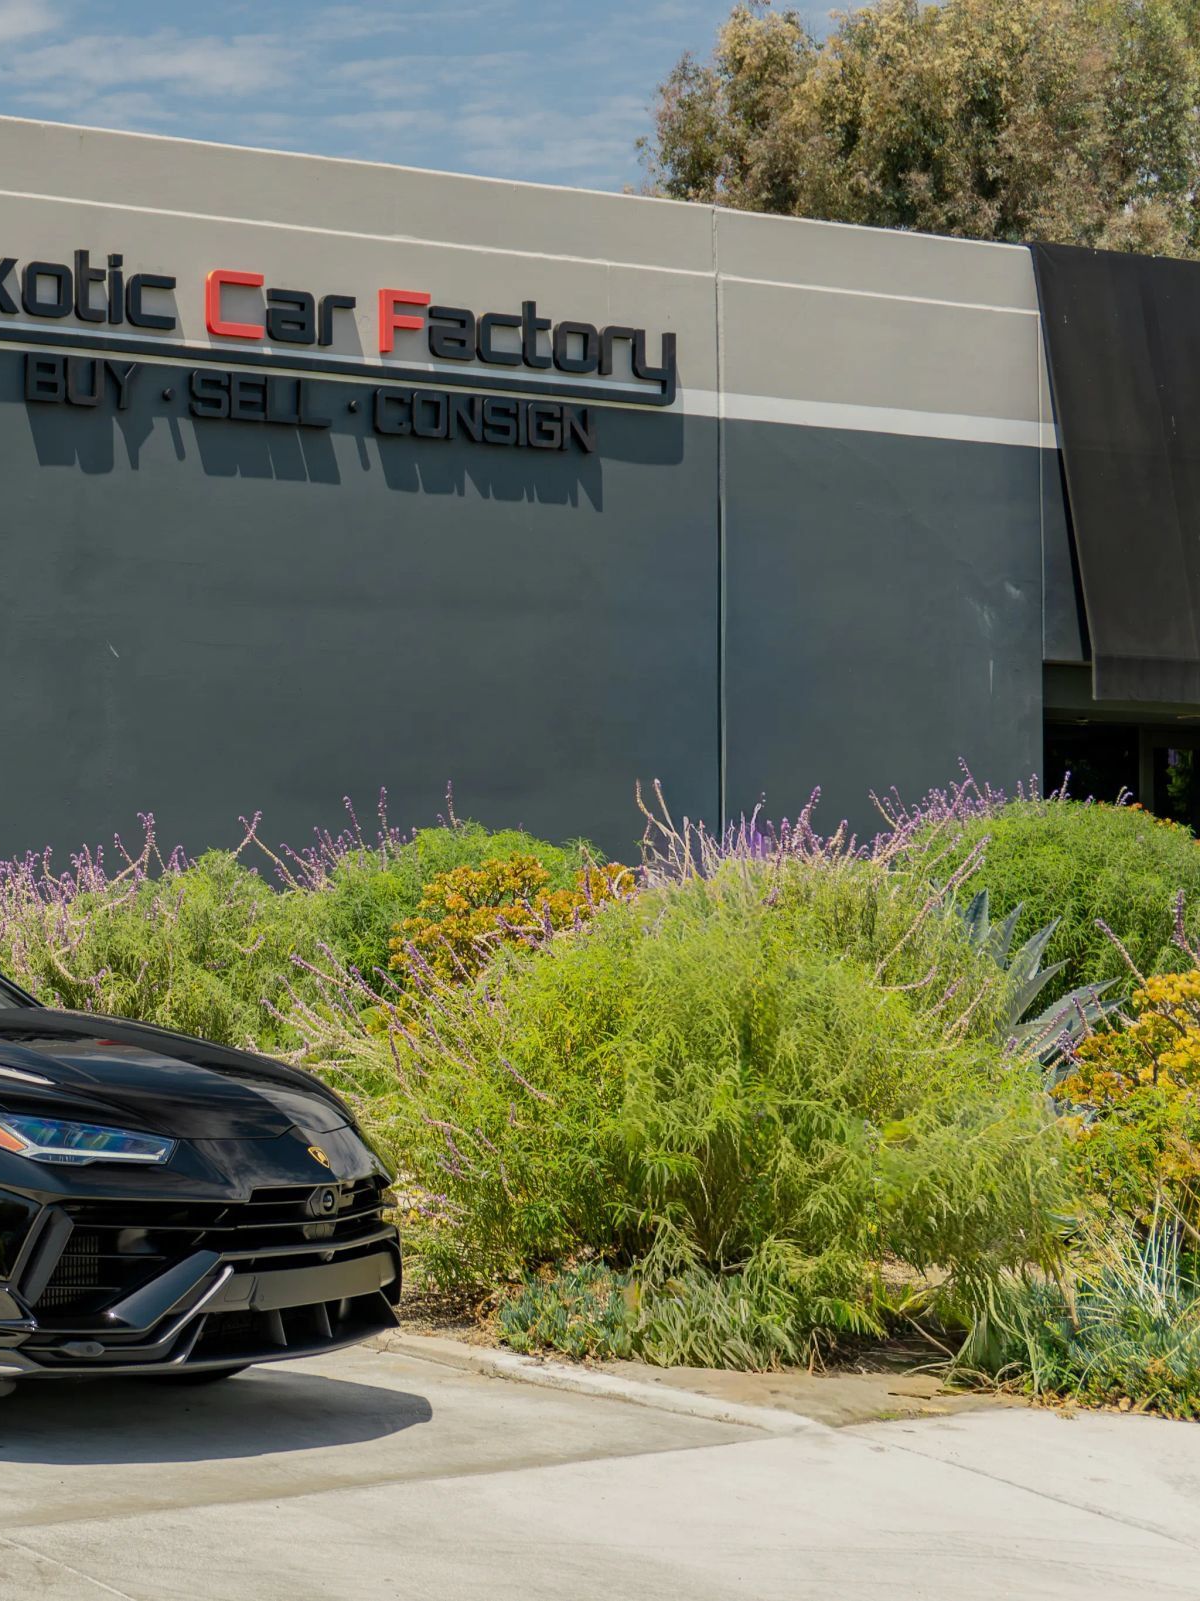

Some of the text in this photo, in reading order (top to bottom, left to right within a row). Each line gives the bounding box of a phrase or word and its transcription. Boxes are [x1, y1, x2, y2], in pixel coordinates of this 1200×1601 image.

[205, 269, 356, 346] Car
[378, 288, 677, 407] Factory
[24, 352, 596, 453] BUY SELL CONSIGN
